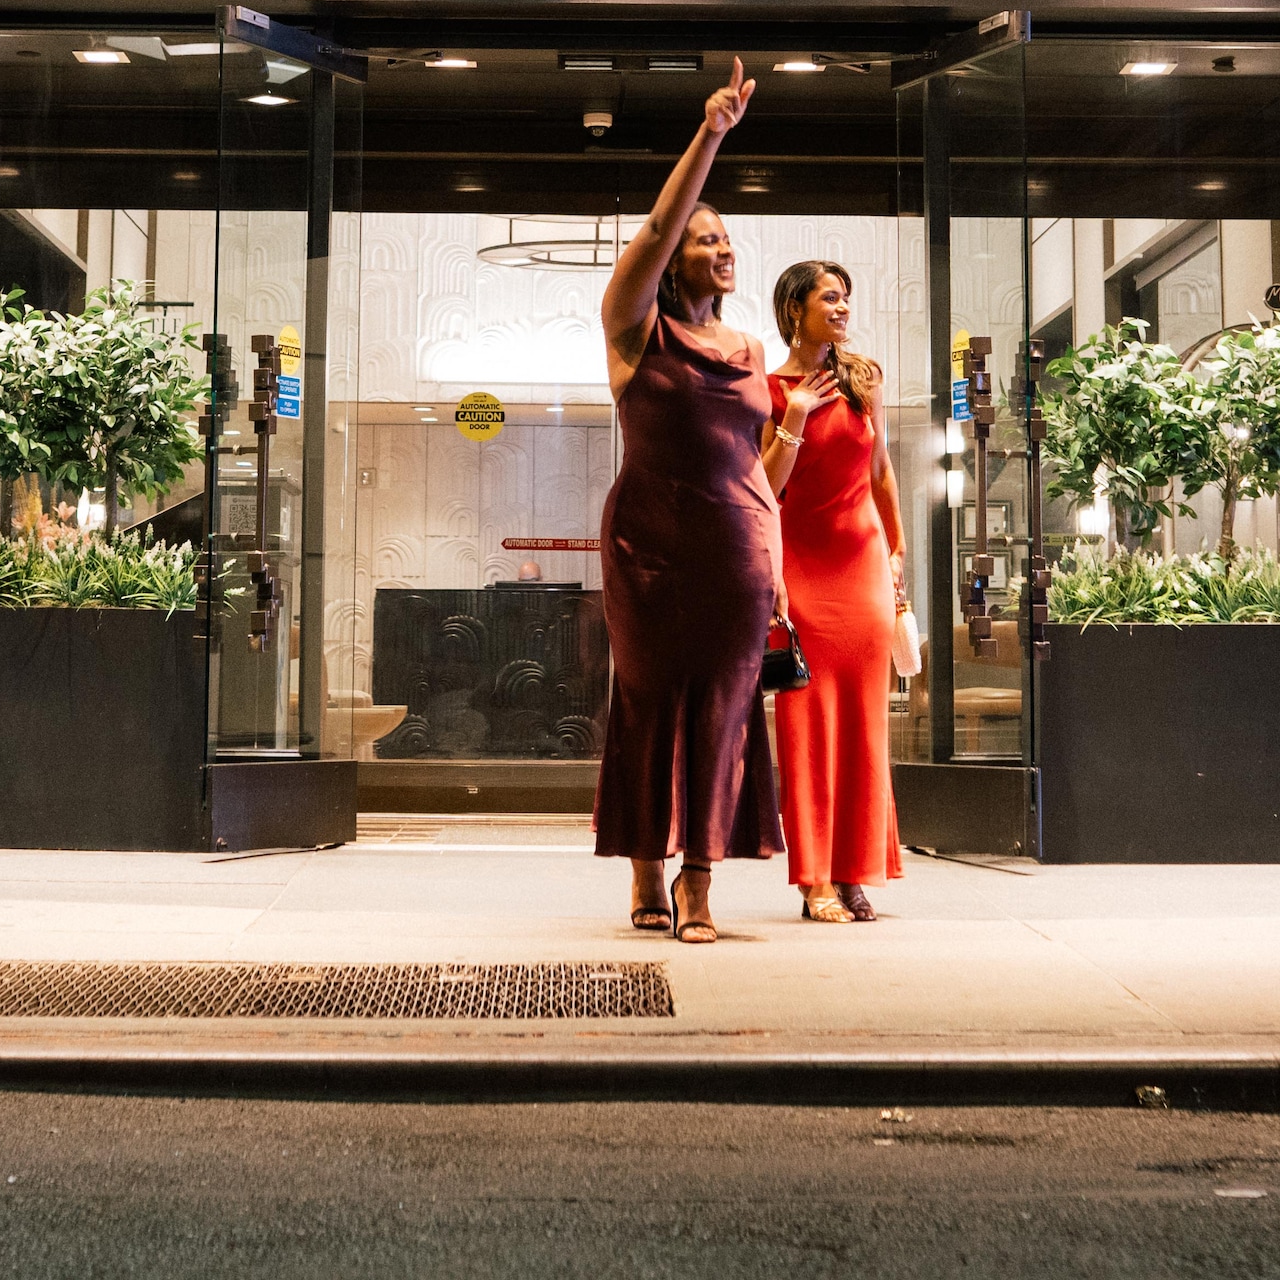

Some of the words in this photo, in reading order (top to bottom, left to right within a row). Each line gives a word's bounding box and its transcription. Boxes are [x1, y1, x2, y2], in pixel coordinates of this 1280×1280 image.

[279, 345, 300, 358] CAUTION
[458, 411, 502, 422] CAUTION
[504, 539, 537, 548] AUTOMATIC
[537, 539, 554, 548] DOOR
[567, 540, 586, 548] STAND
[586, 540, 601, 549] CLEA
